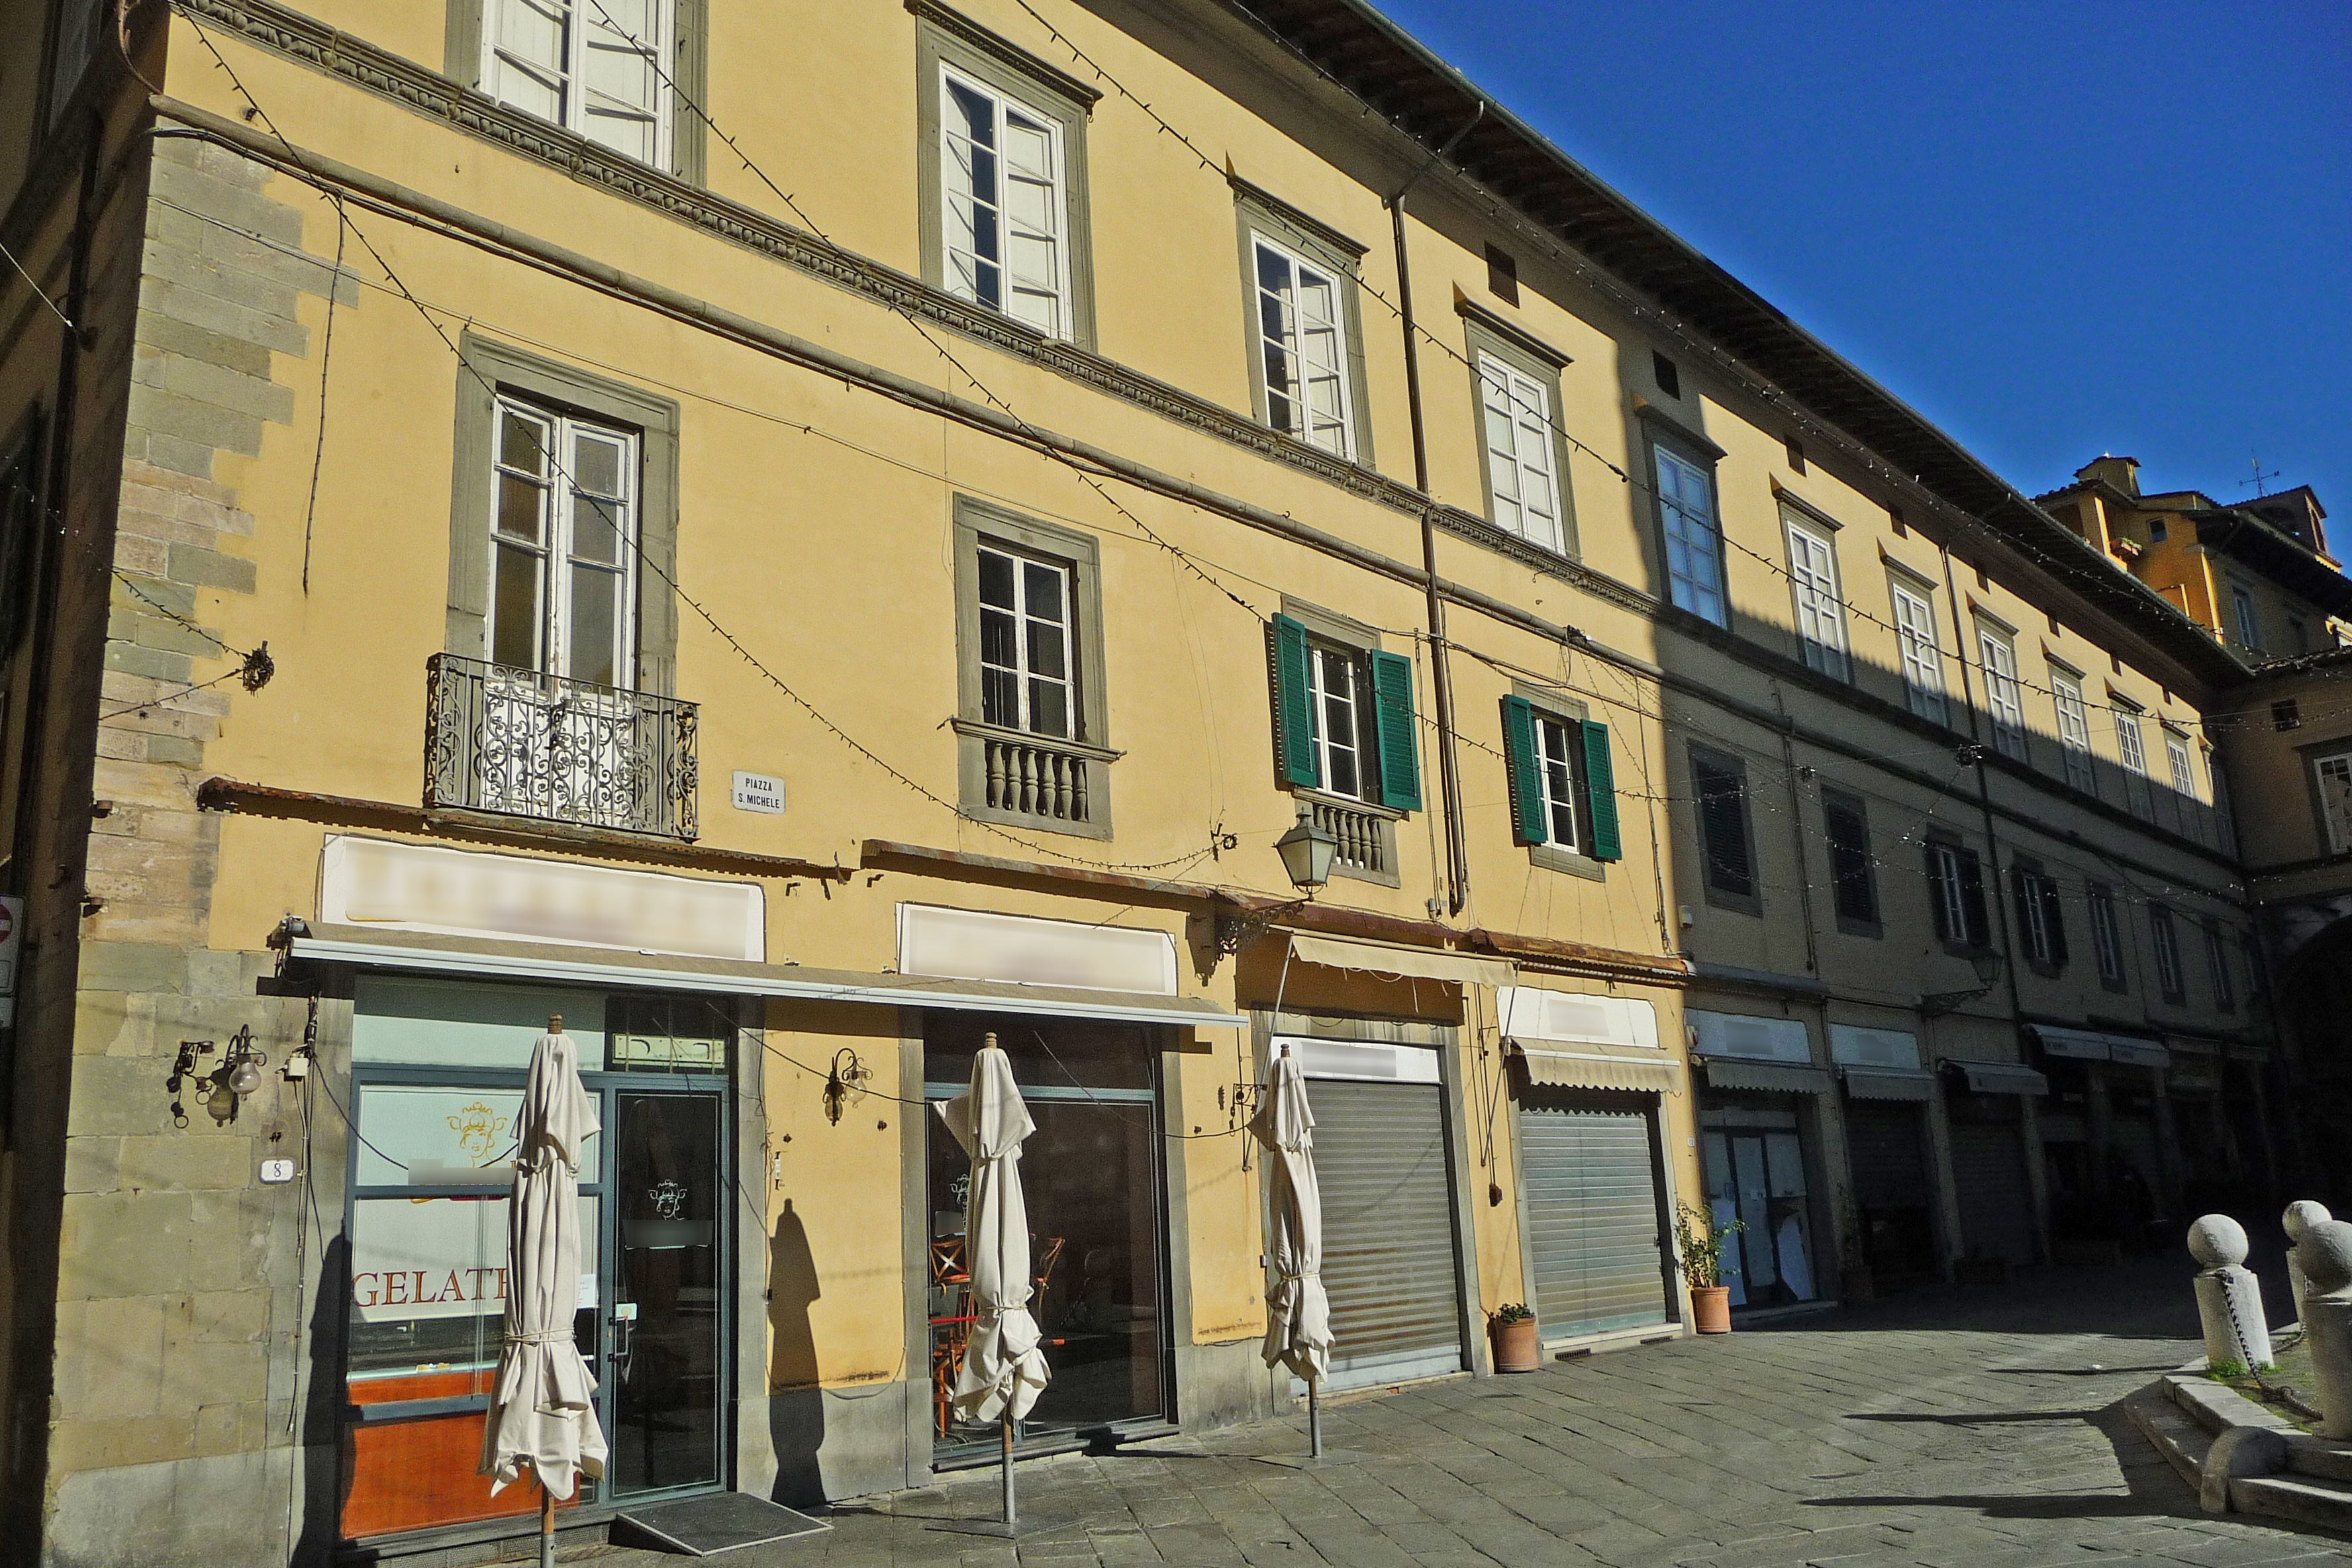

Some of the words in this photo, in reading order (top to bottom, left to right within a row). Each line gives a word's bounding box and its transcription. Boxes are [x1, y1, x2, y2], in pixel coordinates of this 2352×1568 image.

[746, 777, 773, 792] PIAZZA
[738, 793, 745, 803] S.
[747, 794, 780, 808] MICHELE
[273, 1163, 281, 1177] 8
